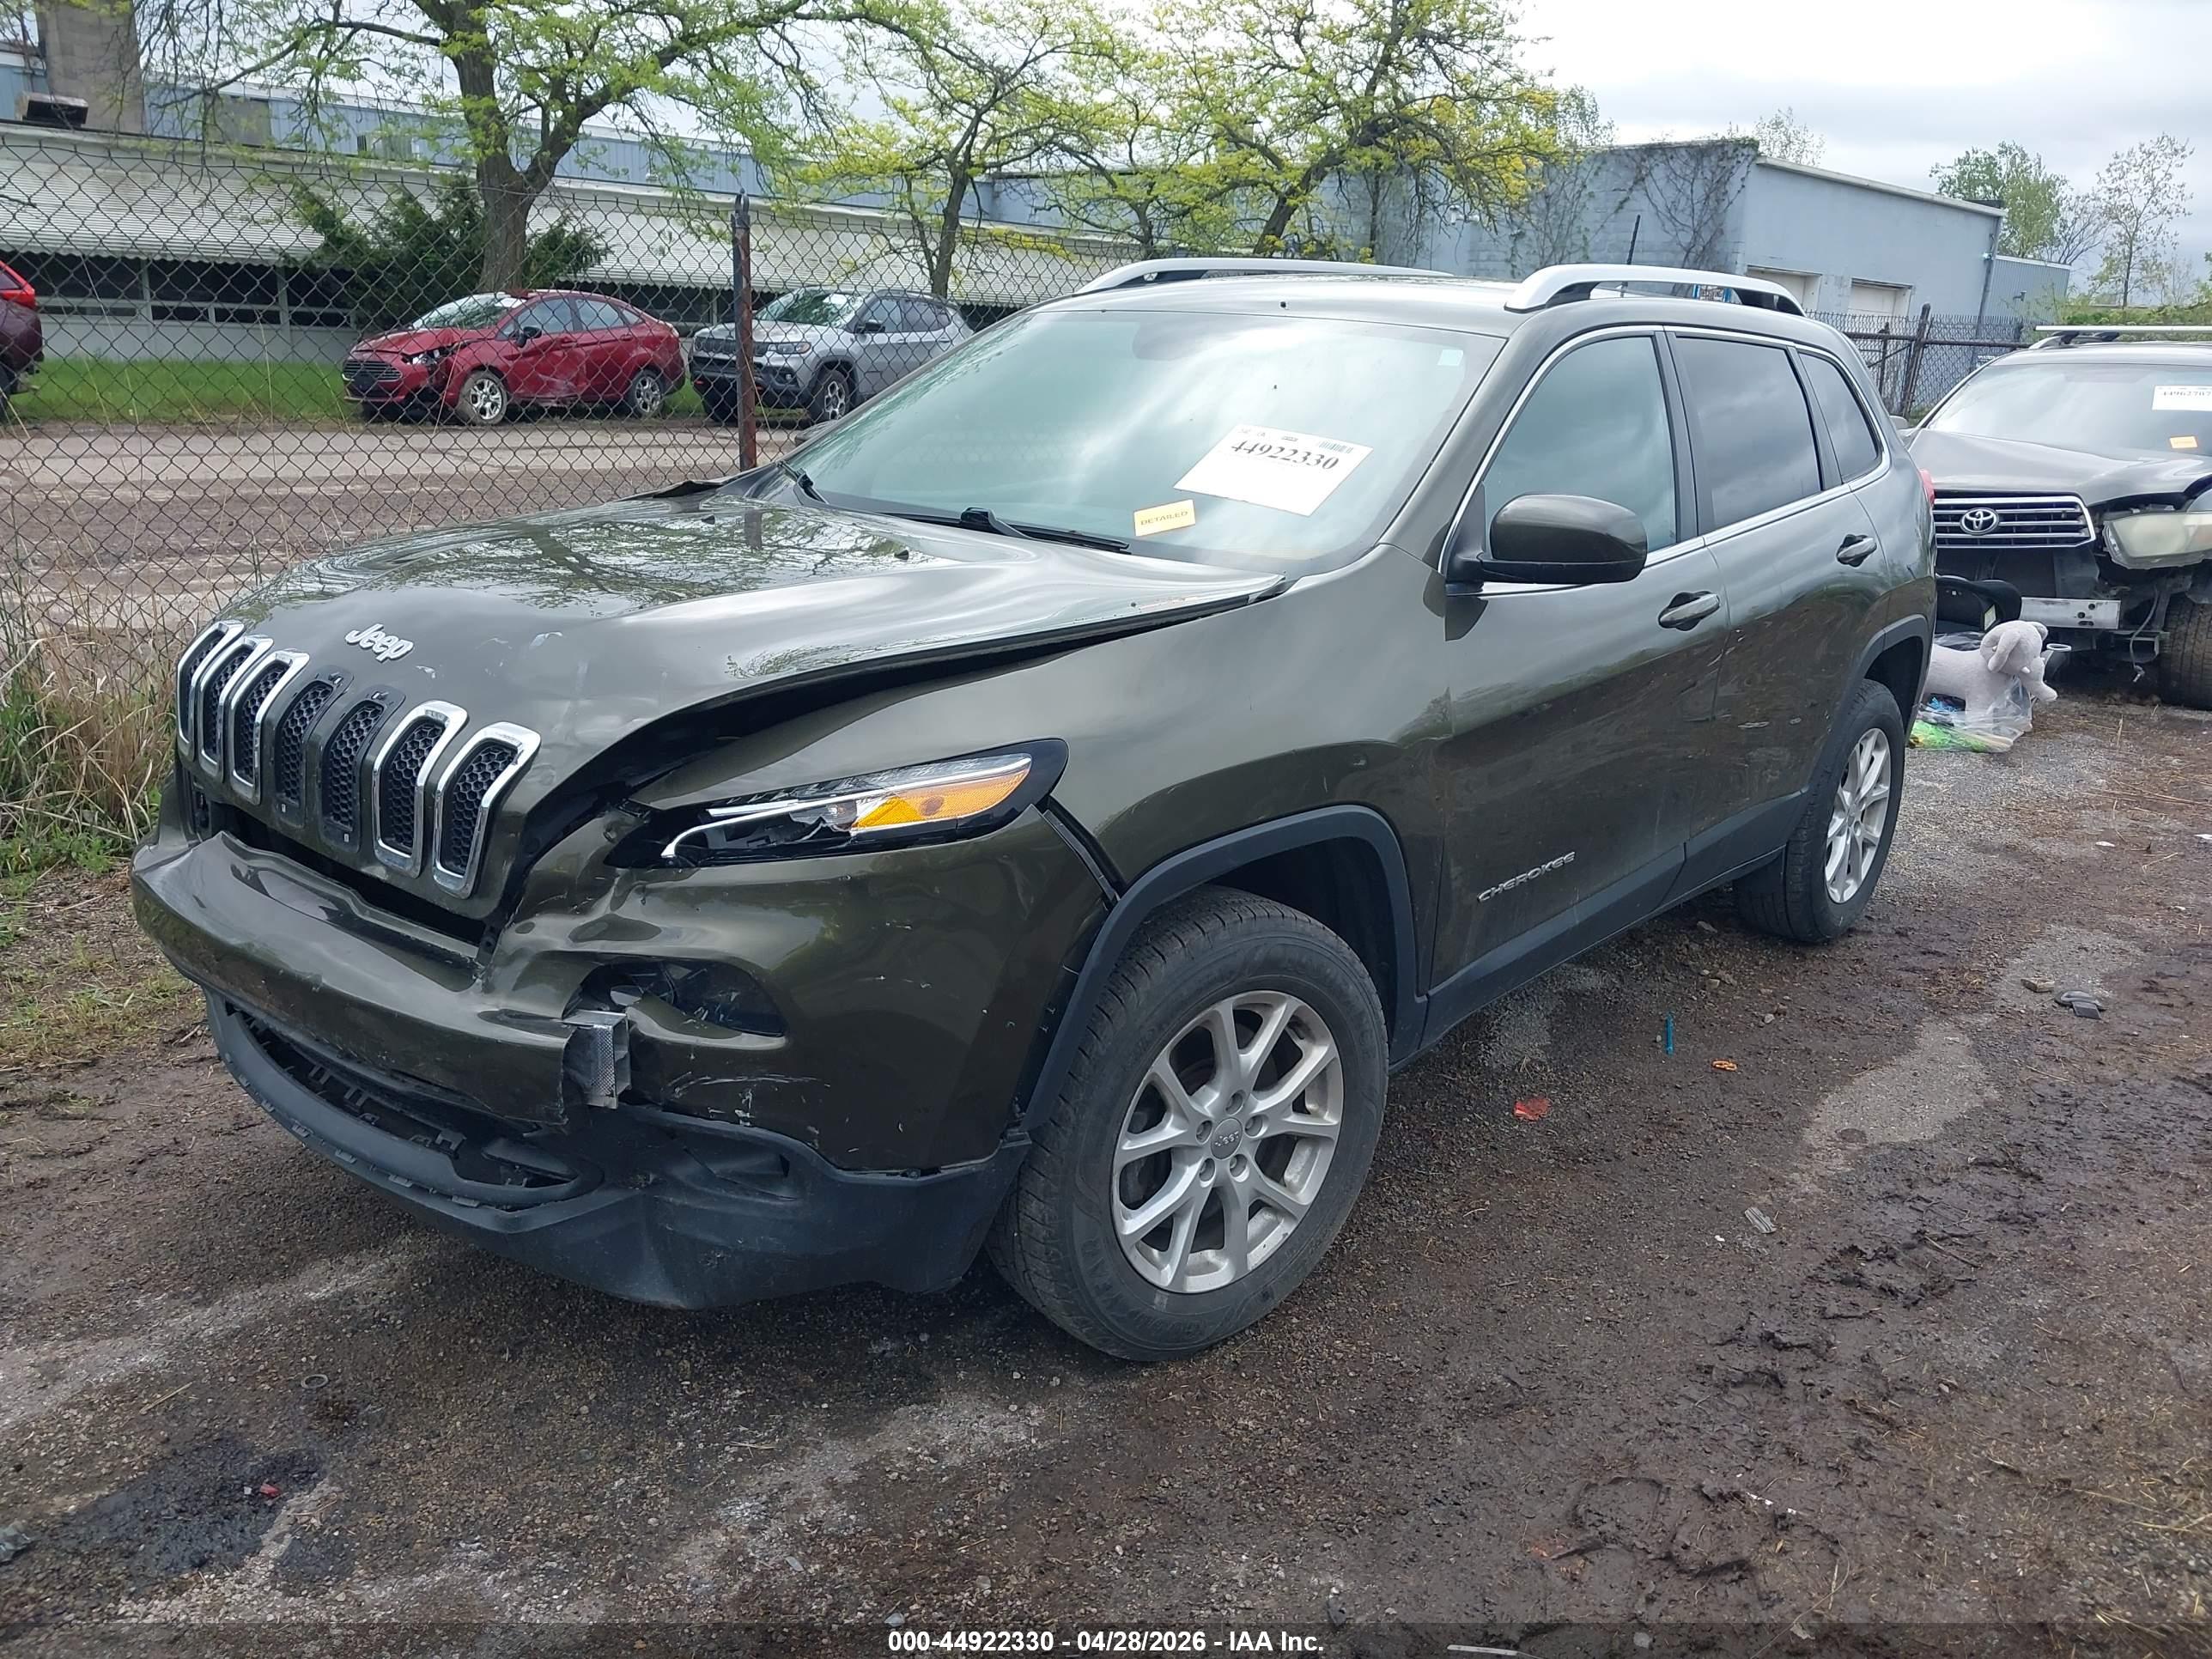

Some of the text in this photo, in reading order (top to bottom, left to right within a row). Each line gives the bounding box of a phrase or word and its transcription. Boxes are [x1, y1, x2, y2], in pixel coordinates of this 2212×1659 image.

[1231, 441, 1339, 470] 44922330
[1140, 511, 1188, 526] DETAILED
[344, 623, 414, 663] Jeep
[1478, 851, 1576, 902] CHEROKEE
